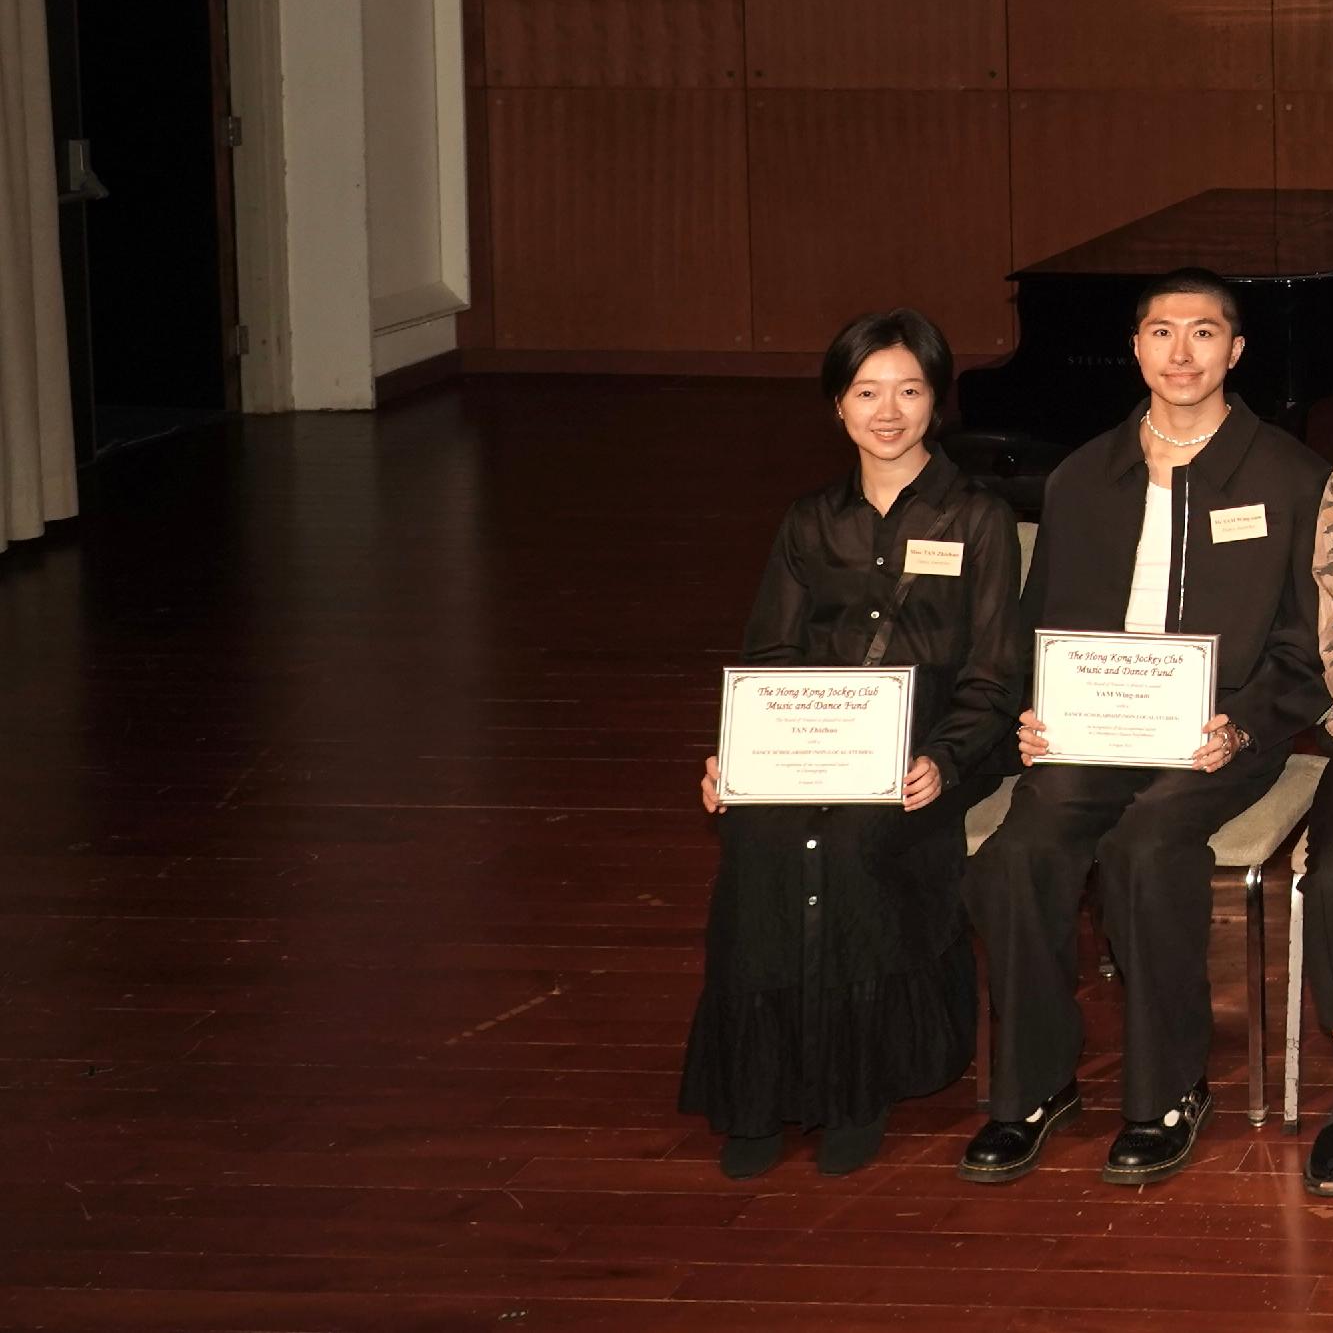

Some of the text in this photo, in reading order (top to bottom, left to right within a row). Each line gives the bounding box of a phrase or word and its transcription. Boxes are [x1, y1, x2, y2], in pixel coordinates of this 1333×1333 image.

[1067, 651, 1184, 666] The Hong Kong Jockey Club
[1076, 665, 1176, 677] Music and Dance Fund
[757, 685, 879, 699] The Hong Kong Jockey Club
[765, 700, 871, 711] Music and Dance Fund
